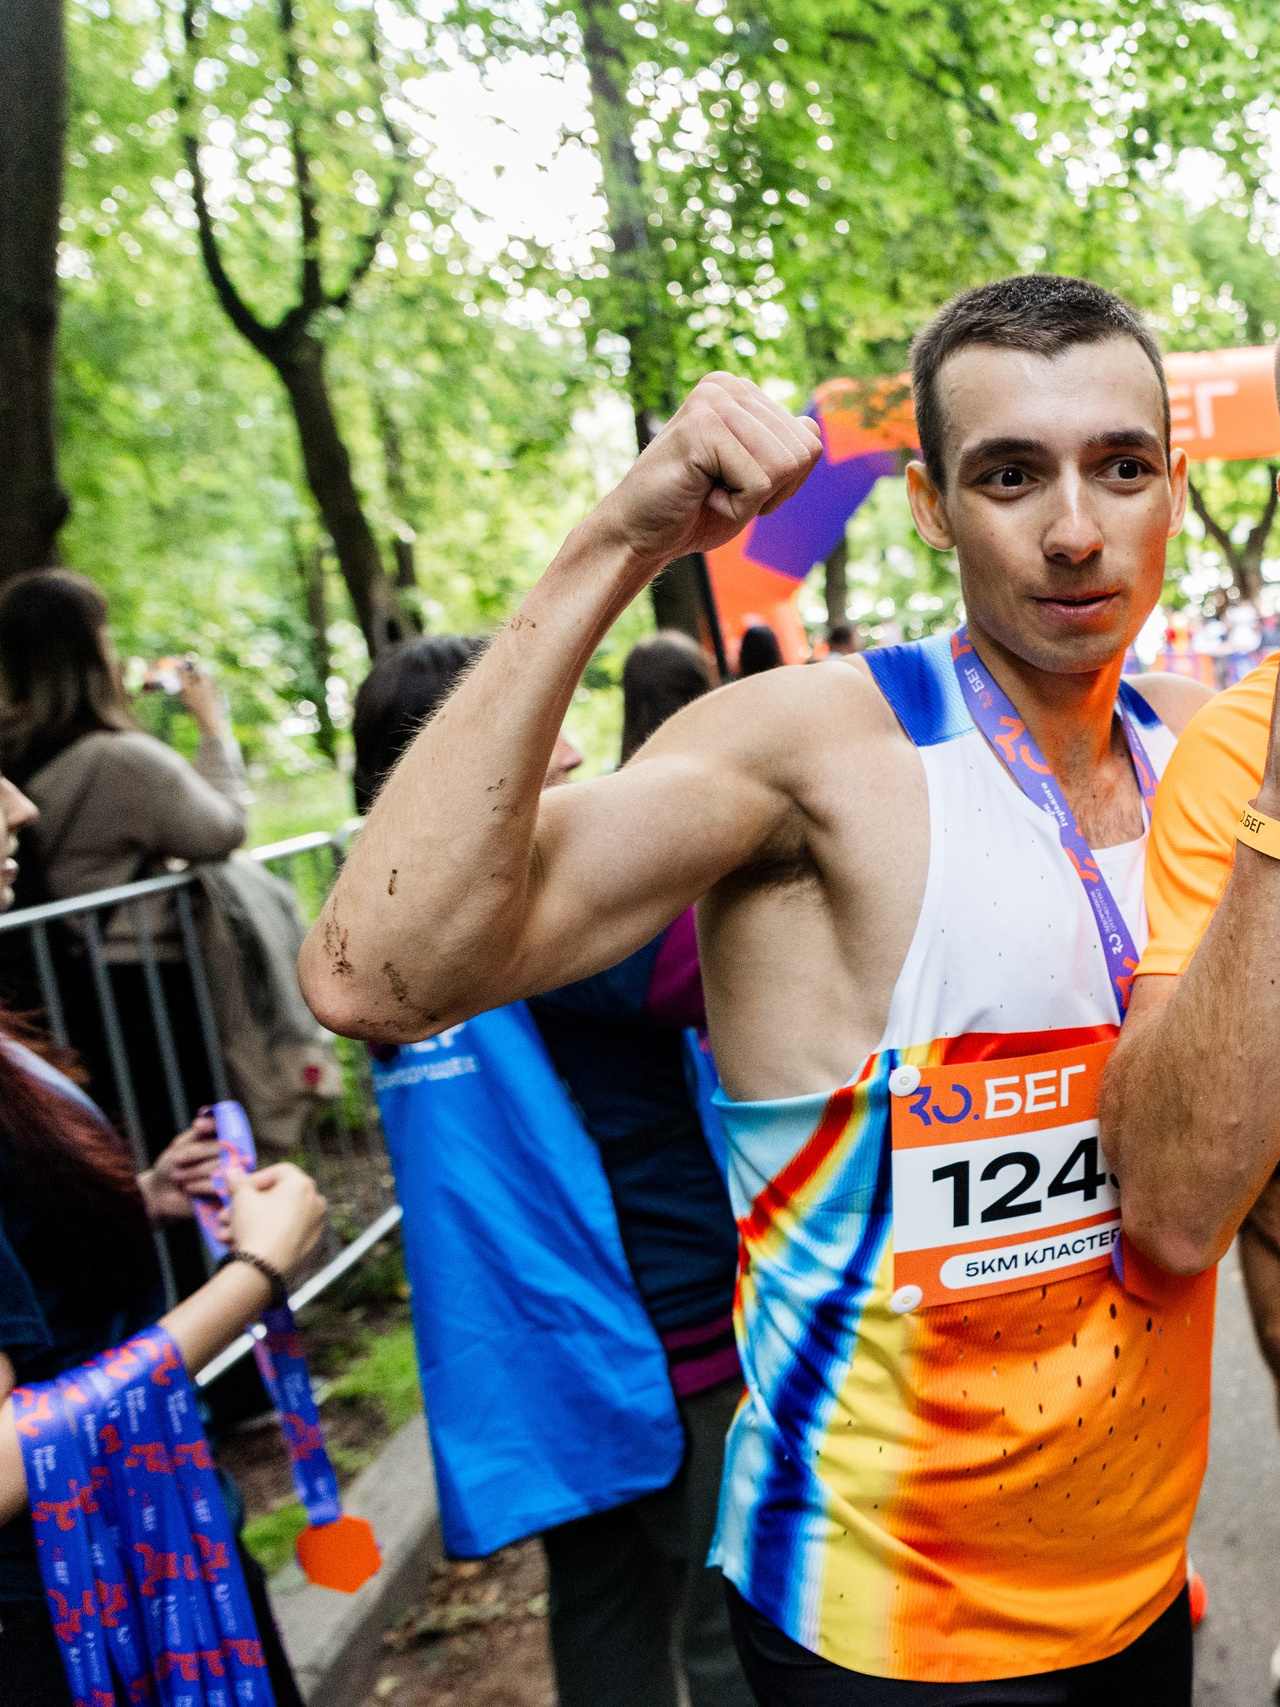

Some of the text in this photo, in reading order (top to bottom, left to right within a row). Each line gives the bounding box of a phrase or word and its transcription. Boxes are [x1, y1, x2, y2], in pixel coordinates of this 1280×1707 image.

[1167, 381, 1238, 442] ЕГ
[932, 1136, 1121, 1228] 124
[965, 1256, 1018, 1278] 5КМ
